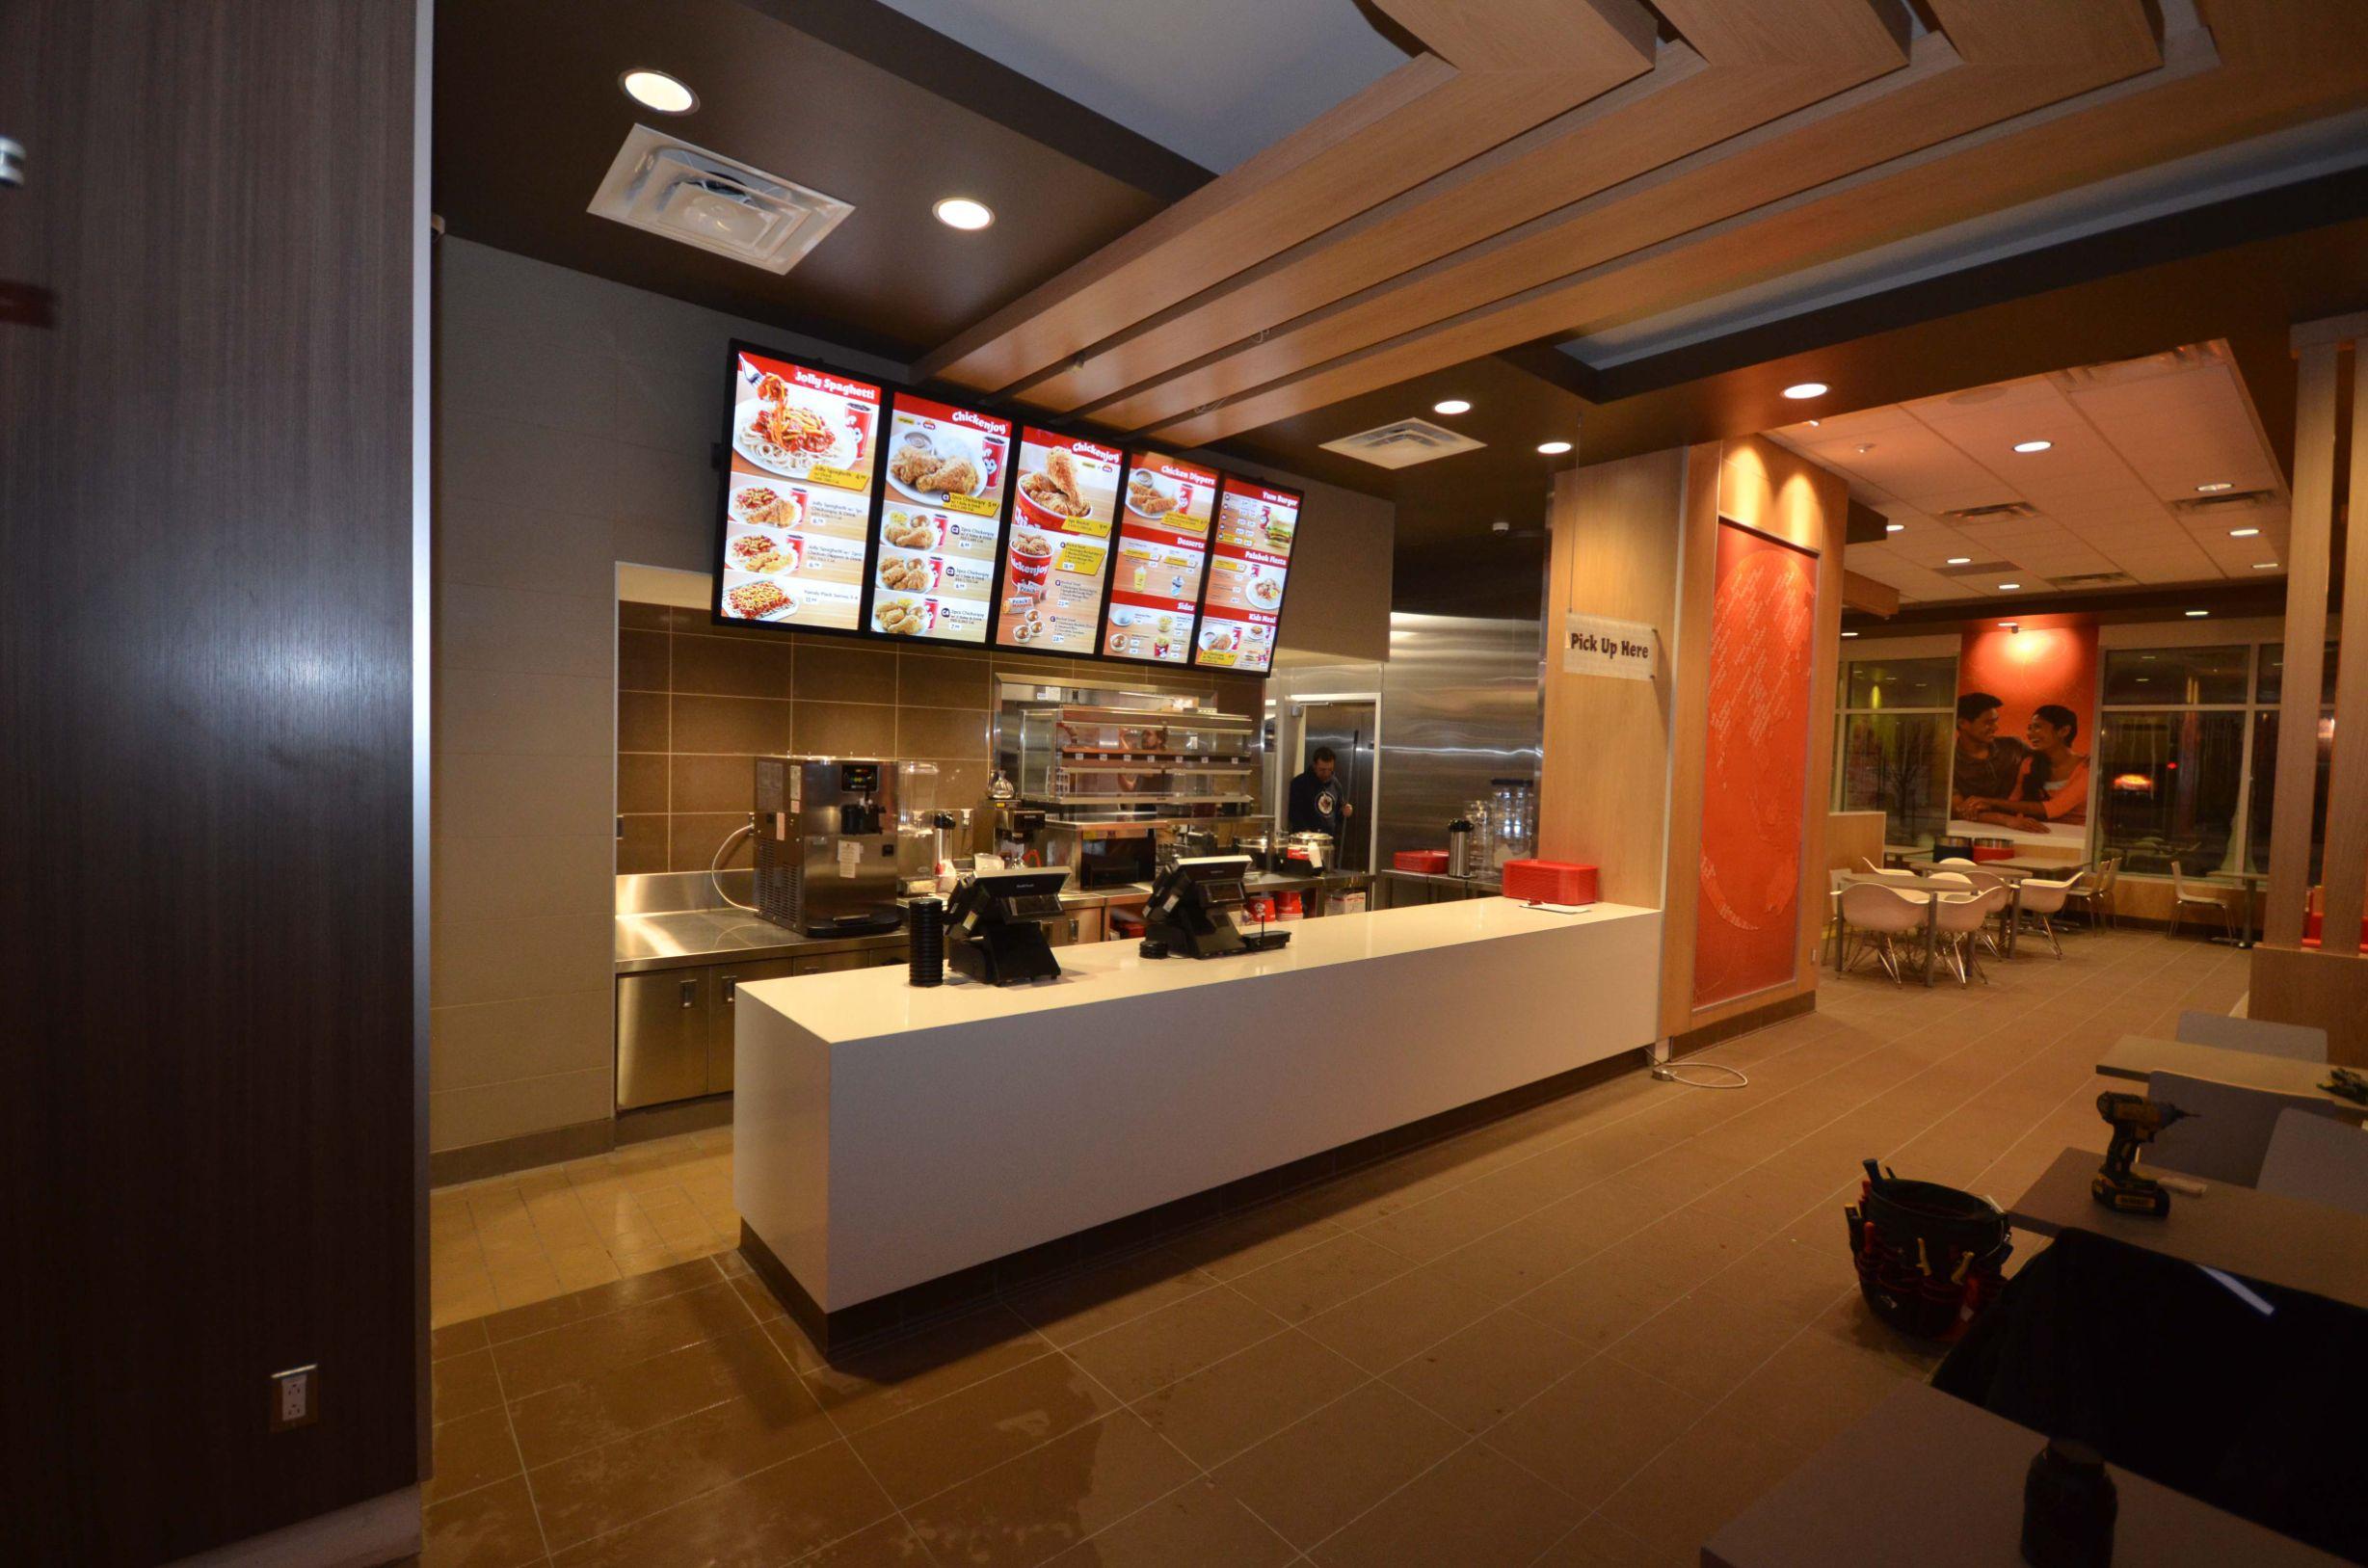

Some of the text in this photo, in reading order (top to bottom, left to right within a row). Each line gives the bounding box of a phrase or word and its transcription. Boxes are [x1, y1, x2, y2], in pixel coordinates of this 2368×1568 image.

[795, 371, 875, 400] Jolly Spaghetti
[951, 411, 1007, 434] Chickenjoy
[1072, 441, 1120, 464] Chickenjoy
[1160, 465, 1215, 485] Chicken Dippers
[1262, 491, 1277, 502] Yum
[1277, 494, 1298, 507] Burger
[1177, 537, 1206, 548] Desserts
[1177, 602, 1195, 612] Sides
[1248, 613, 1277, 624] Kids Meal
[1570, 632, 1649, 659] Pick Up Here
